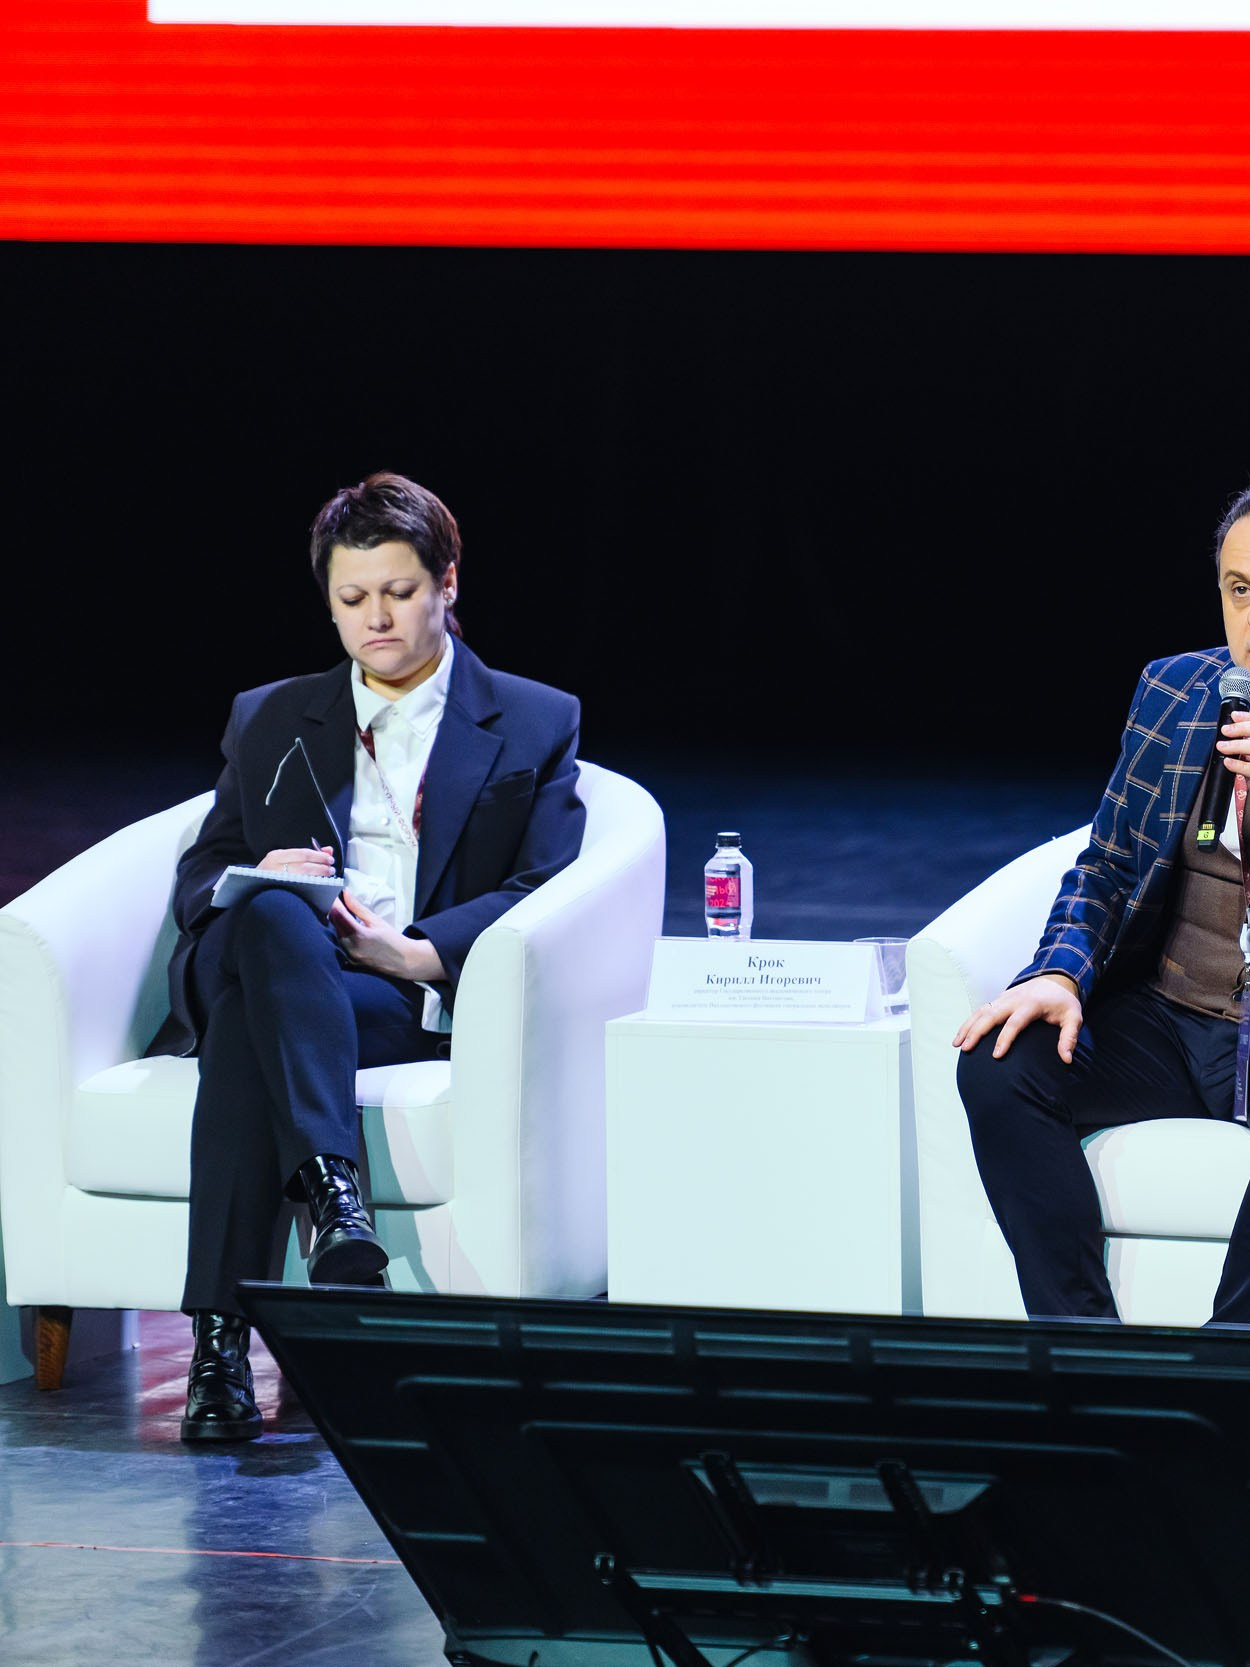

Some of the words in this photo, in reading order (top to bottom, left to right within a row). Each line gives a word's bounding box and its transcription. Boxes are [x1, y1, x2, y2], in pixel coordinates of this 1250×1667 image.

[748, 956, 785, 971] Крок
[706, 974, 755, 987] Кирилл
[759, 974, 822, 987] Игоревич
